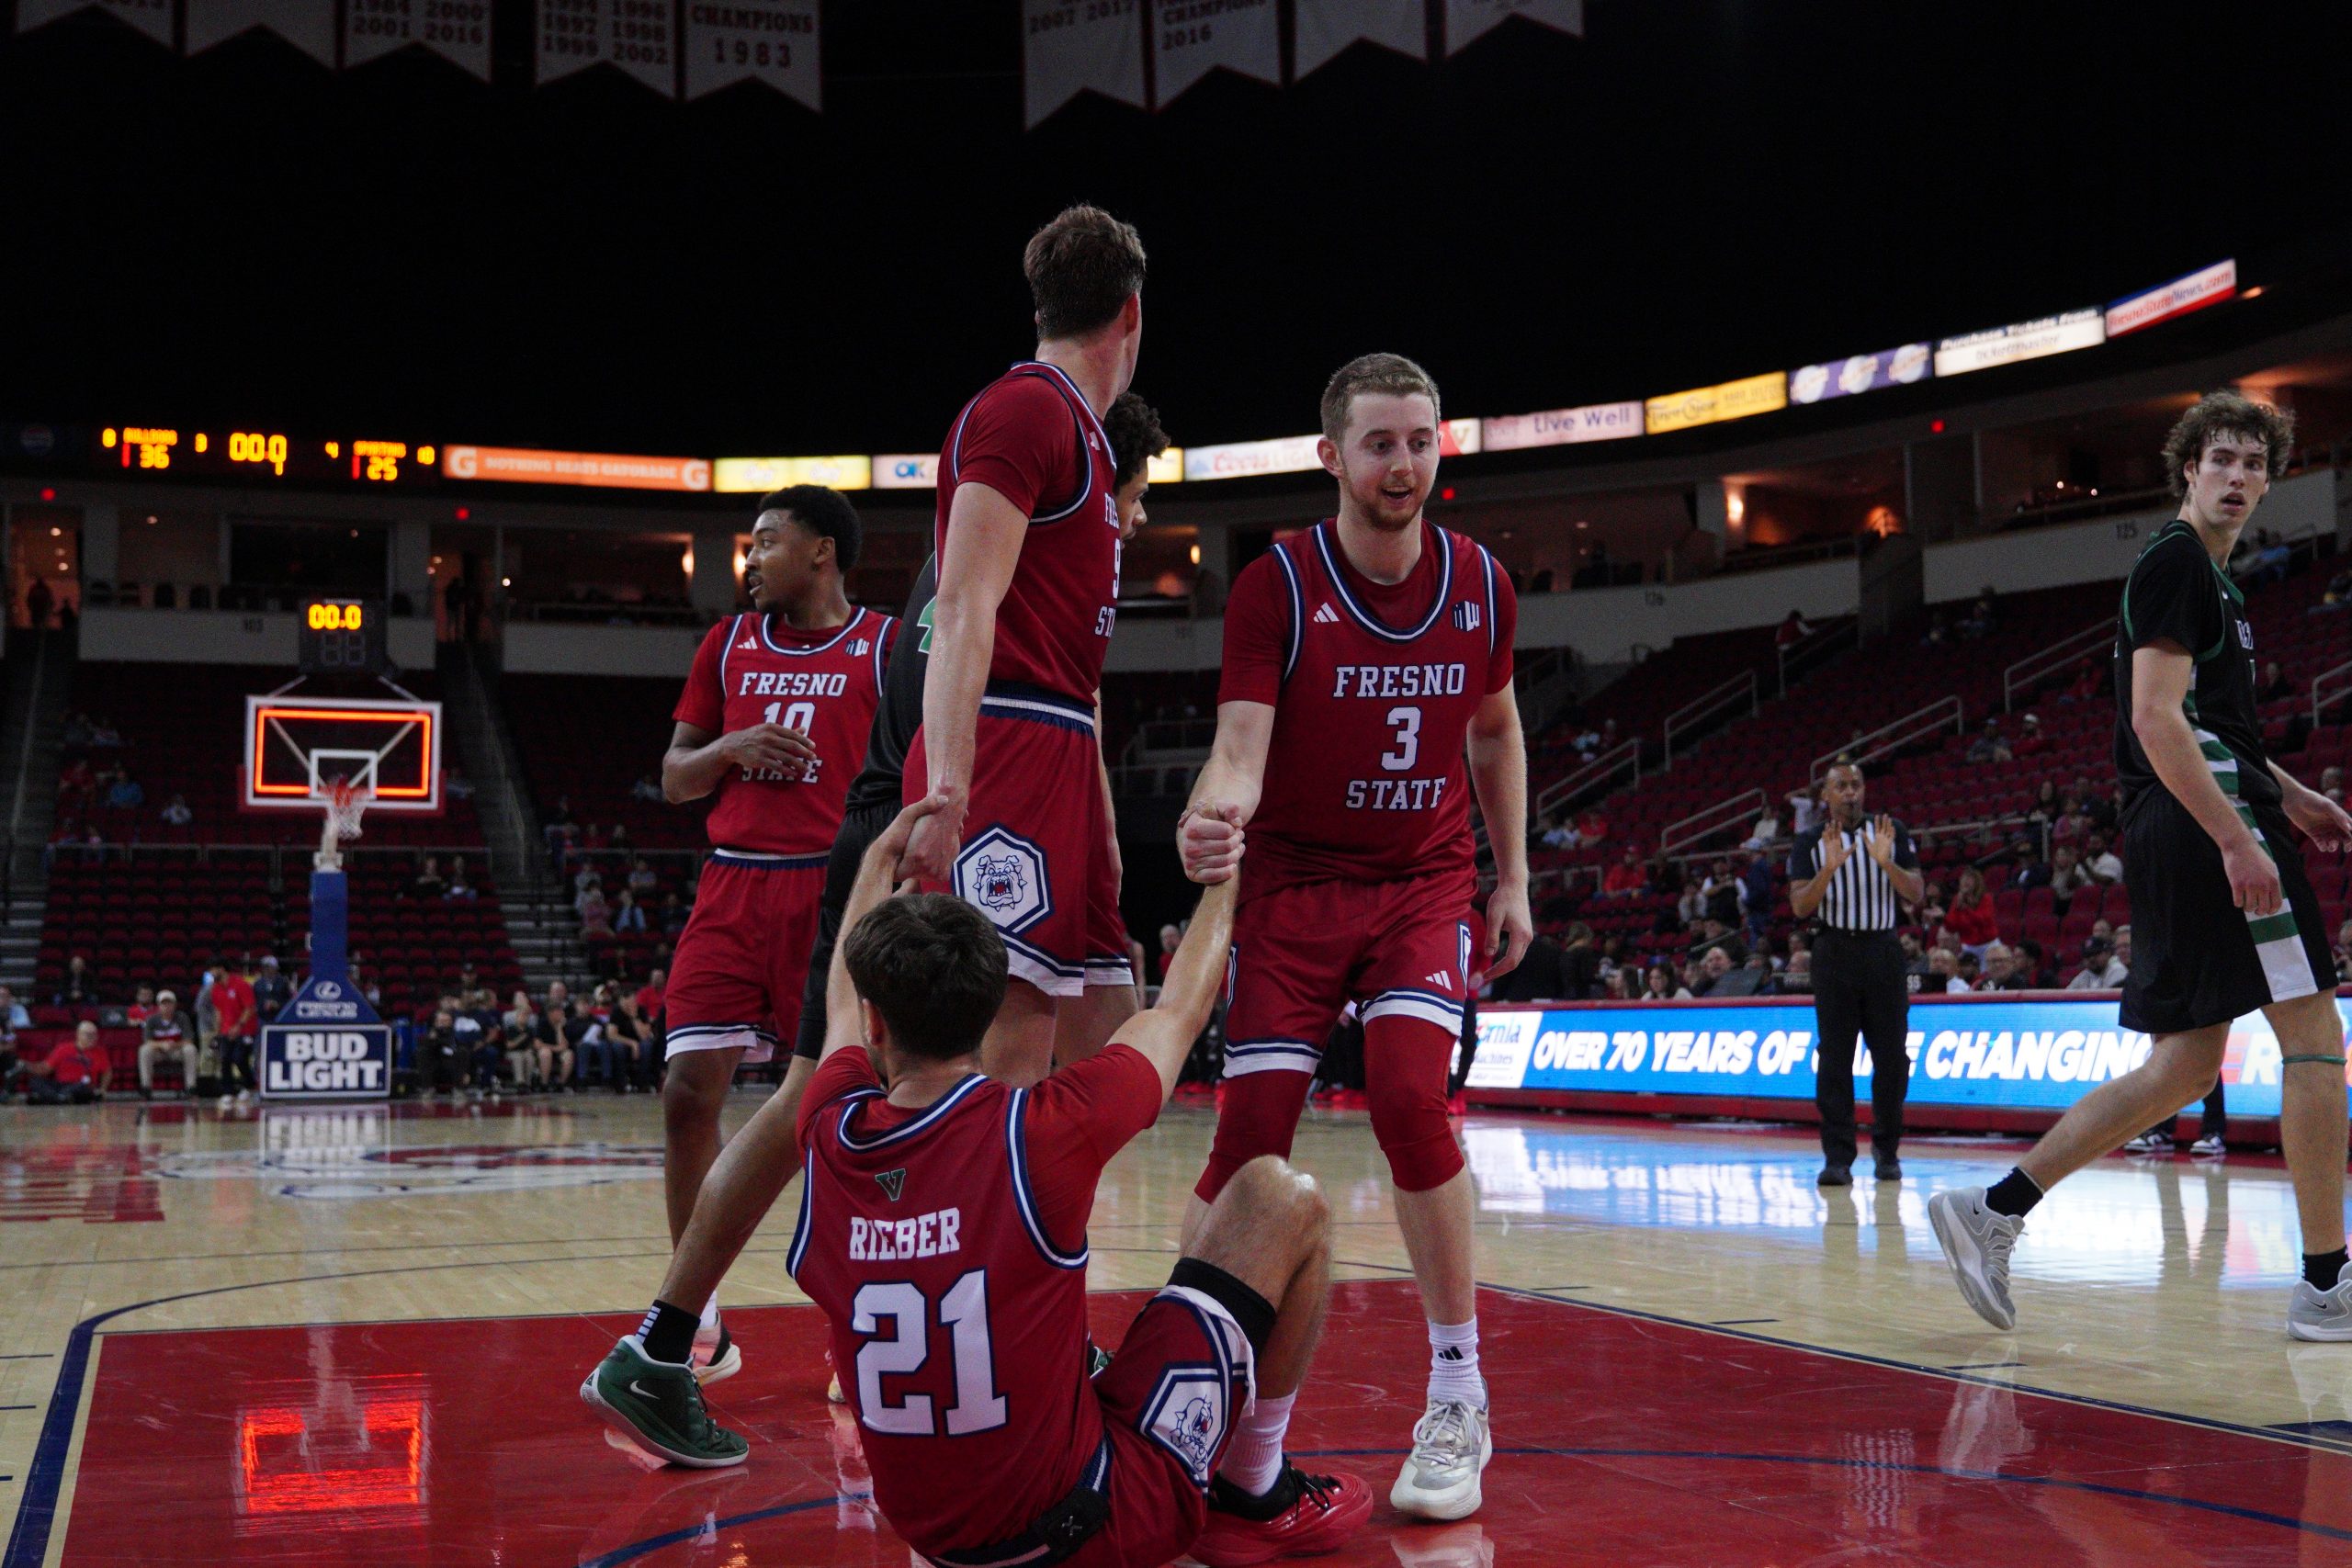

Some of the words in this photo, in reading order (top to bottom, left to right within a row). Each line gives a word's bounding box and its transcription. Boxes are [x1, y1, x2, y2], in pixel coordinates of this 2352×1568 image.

[691, 4, 814, 33] CHAMPIONS
[1161, 23, 1212, 51] 2016
[613, 40, 669, 65] 2002
[715, 37, 793, 68] 1983
[1533, 414, 1576, 434] Live
[1585, 407, 1631, 427] Well
[450, 447, 478, 478] G
[682, 460, 709, 490] G
[309, 604, 362, 630] 00.0
[739, 671, 848, 697] FRESNO
[1332, 663, 1466, 698] FRESNO
[1380, 705, 1422, 772] 3
[285, 1032, 368, 1062] BUD
[1532, 1031, 1603, 1070] OVER
[1605, 1031, 1650, 1072] 70
[1650, 1031, 1753, 1074] YEARS
[1757, 1030, 1812, 1076] OF
[268, 1060, 384, 1090] LIGHT
[875, 1168, 907, 1202] V
[849, 1207, 961, 1261] RIEBER
[852, 1265, 1011, 1438] 21
